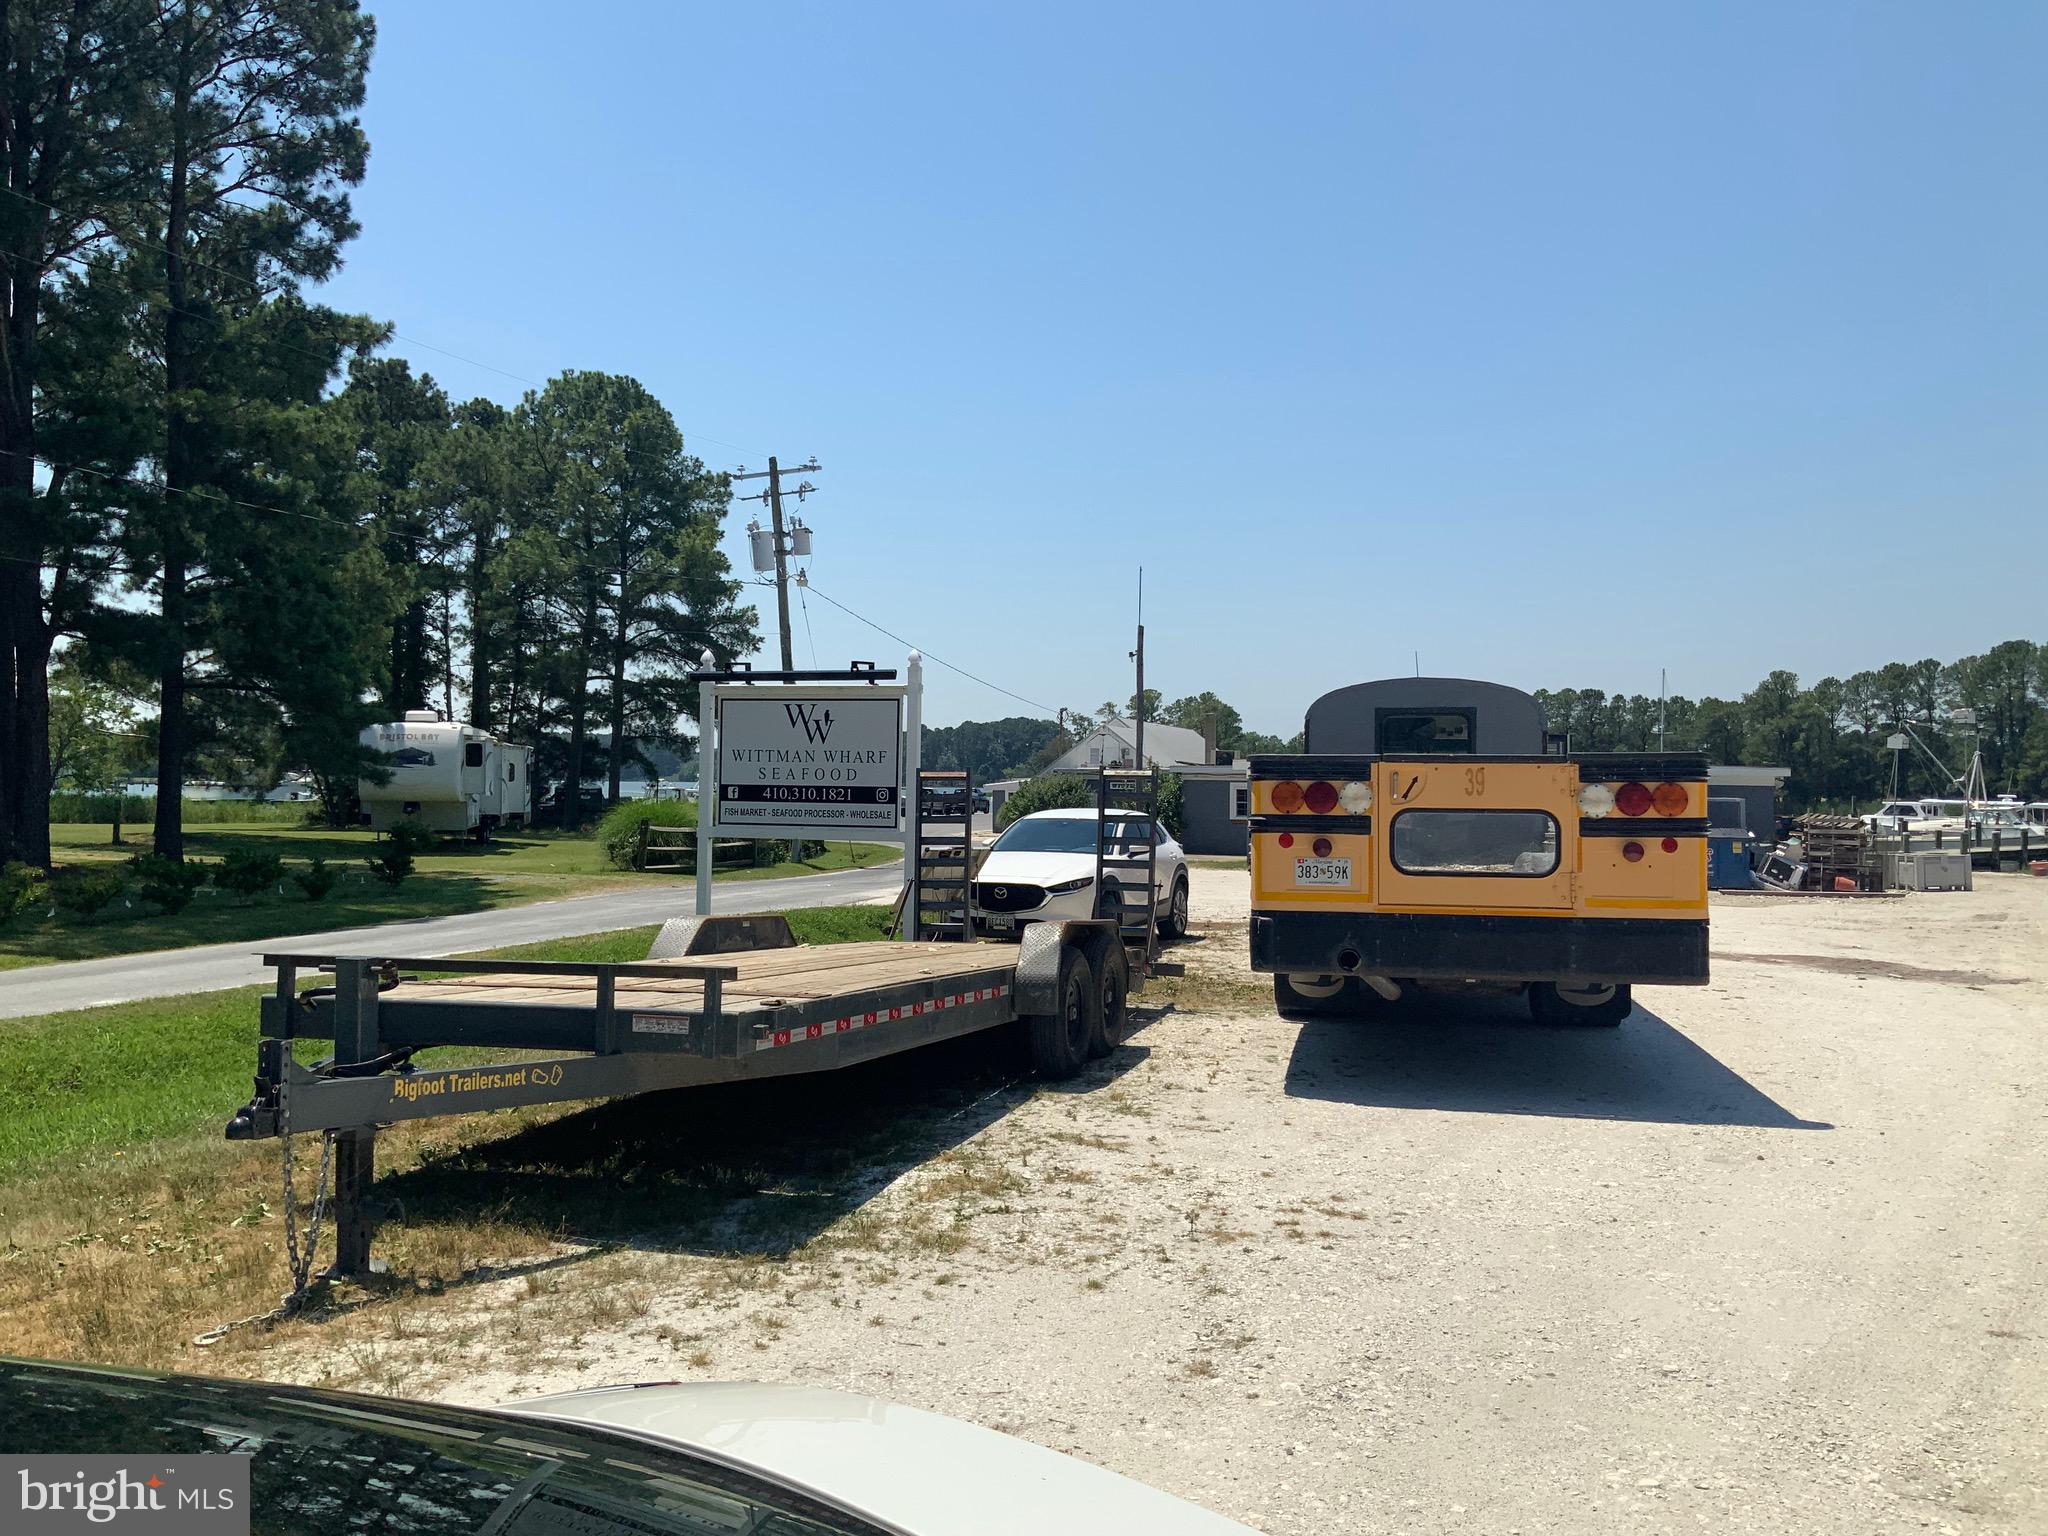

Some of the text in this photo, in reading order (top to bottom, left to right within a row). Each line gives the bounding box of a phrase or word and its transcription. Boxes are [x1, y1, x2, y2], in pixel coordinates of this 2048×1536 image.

[379, 733, 440, 742] BRISTOL BAY
[732, 749, 887, 764] WITTMAN WHARF
[758, 767, 857, 781] SEAFOOD
[1464, 768, 1486, 797] 39
[762, 787, 852, 801] 410.310.1821
[724, 807, 739, 816] FISH
[740, 808, 766, 817] MARKET
[771, 808, 803, 818] SEAFOOD
[804, 809, 845, 818] PROCESSOR
[850, 809, 892, 819] WHOLESALE
[1297, 865, 1348, 880] 383 59K
[394, 1068, 527, 1102] Bigfoot Trailers.net
